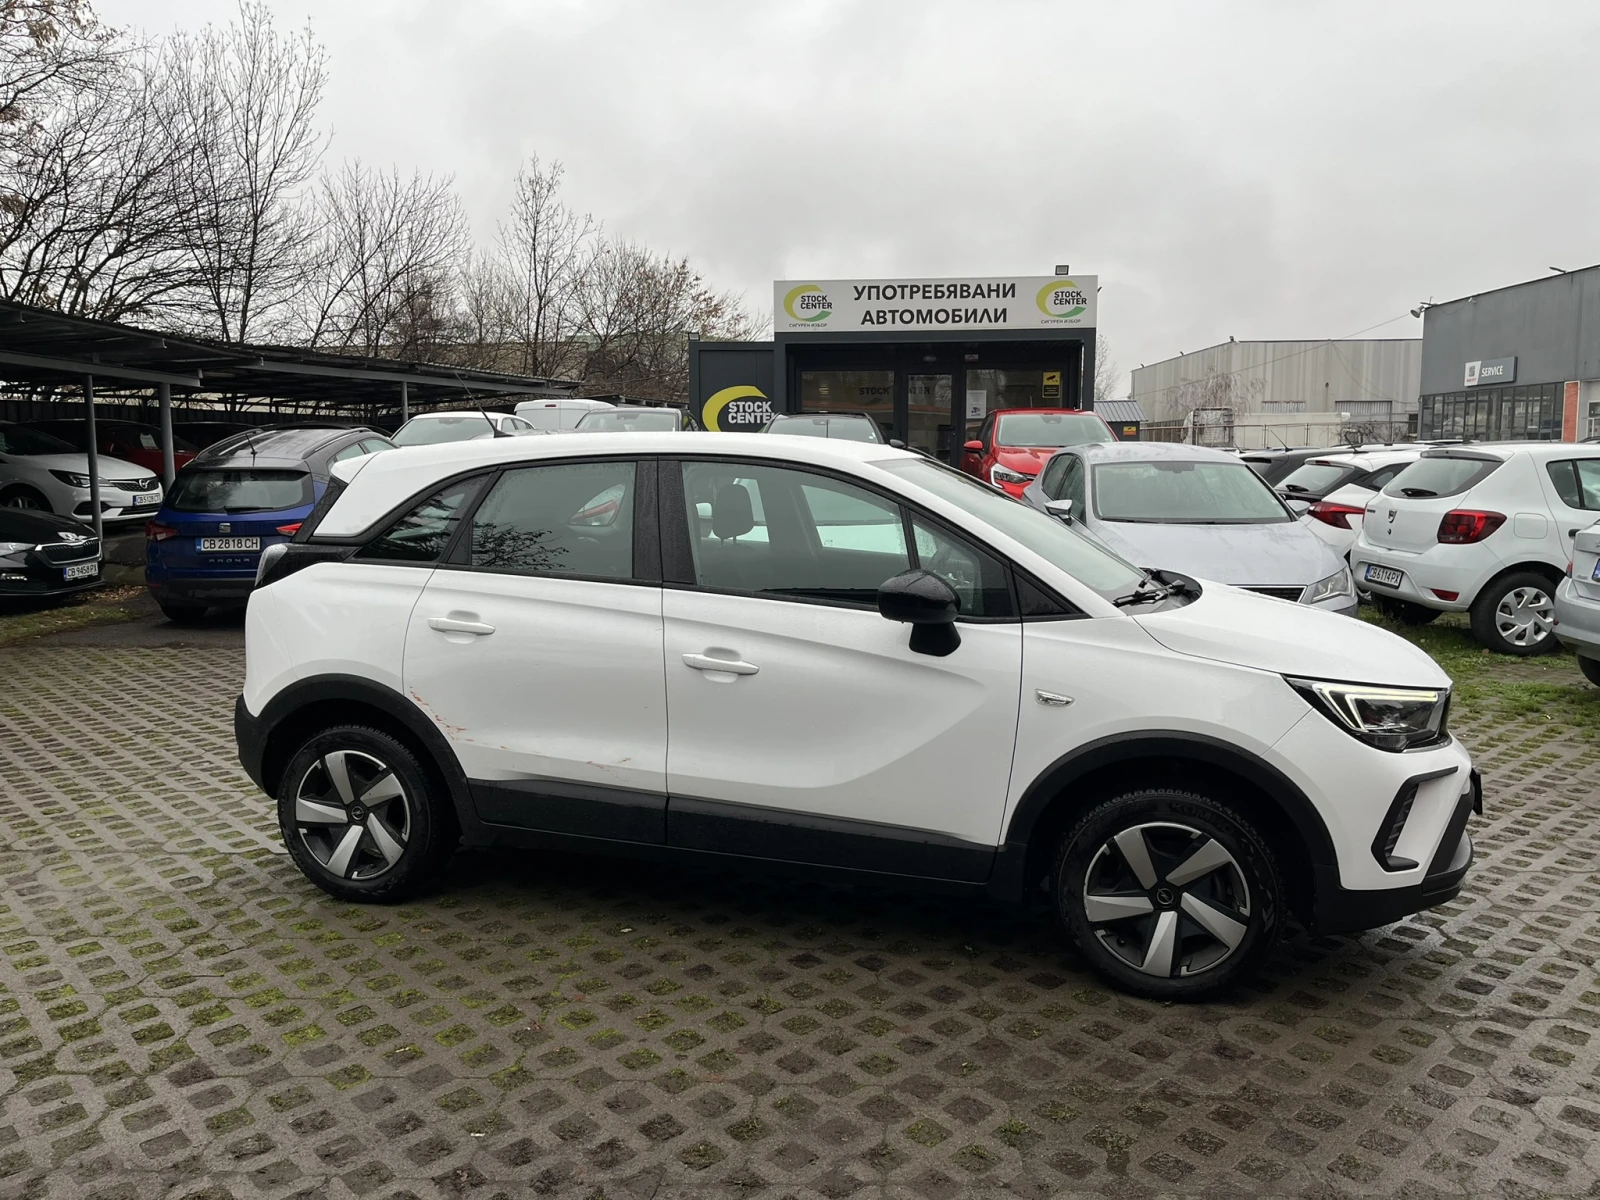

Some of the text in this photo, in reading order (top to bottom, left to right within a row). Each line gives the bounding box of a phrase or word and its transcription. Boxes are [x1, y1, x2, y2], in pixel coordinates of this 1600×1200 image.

[853, 283, 1016, 300] УПОТРЕБЯВАНИ
[860, 308, 1007, 325] АВТОМОБИЛИ
[1481, 365, 1503, 377] SERVICE
[858, 387, 890, 396] STOCK
[728, 401, 772, 412] STOCK
[203, 538, 258, 549] CB 2818 CH
